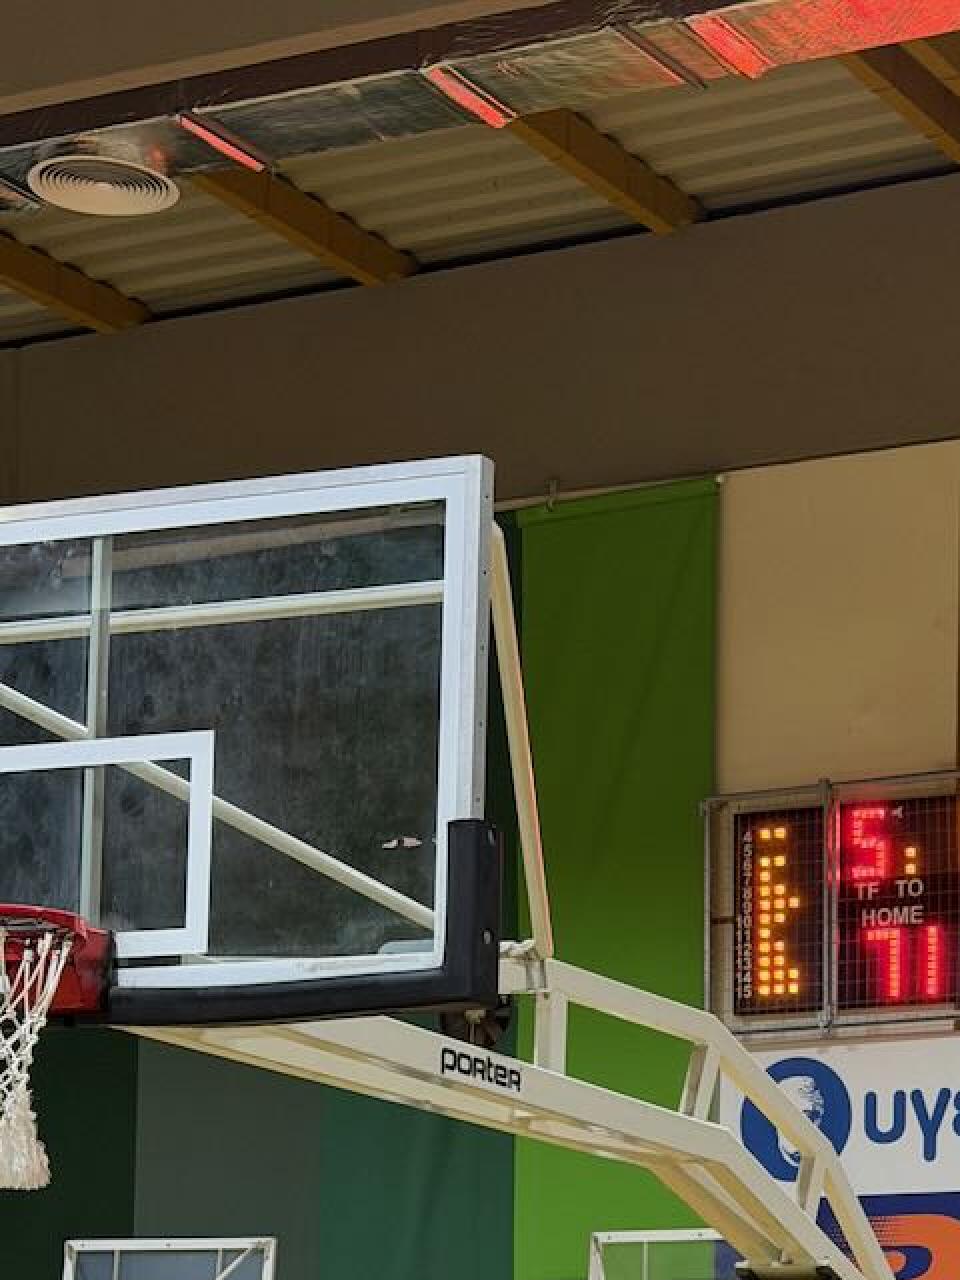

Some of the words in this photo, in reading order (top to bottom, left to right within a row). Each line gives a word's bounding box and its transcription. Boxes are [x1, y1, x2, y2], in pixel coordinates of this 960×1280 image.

[852, 807, 886, 878] 5
[854, 882, 880, 900] TF
[896, 879, 924, 898] TO
[861, 905, 924, 927] HOME
[867, 926, 938, 997] 71
